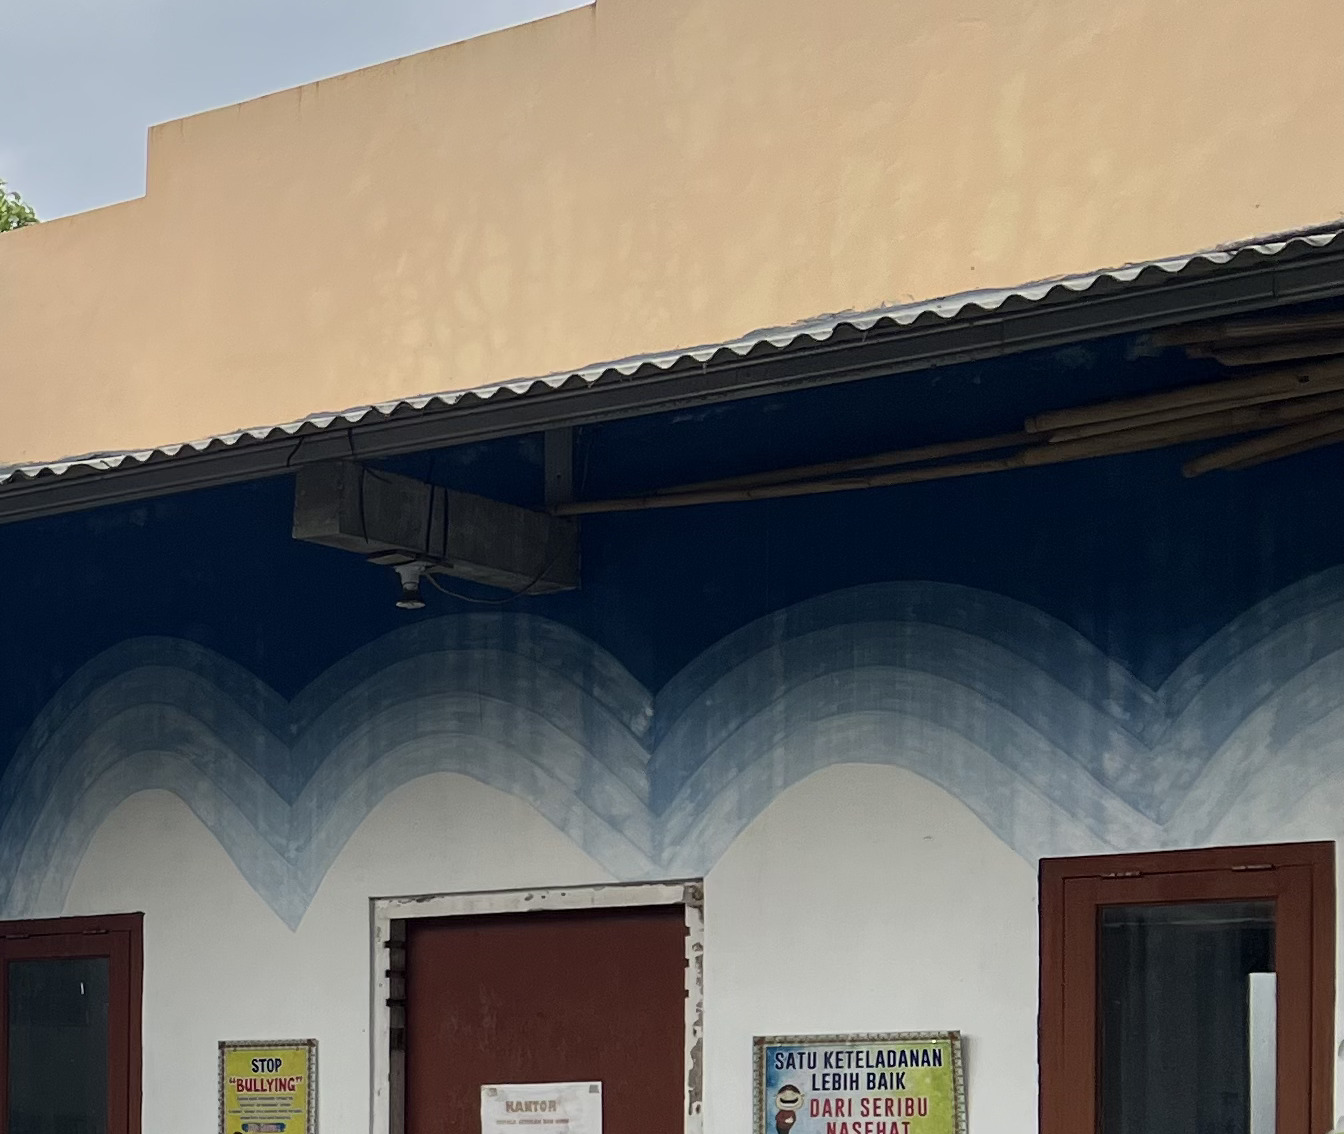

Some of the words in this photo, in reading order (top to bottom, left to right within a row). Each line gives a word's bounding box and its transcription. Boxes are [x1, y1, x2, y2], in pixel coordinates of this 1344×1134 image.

[251, 1058, 283, 1073] STOP
[775, 1051, 817, 1070] SATU
[824, 1048, 943, 1070] KETELADANAN
[228, 1076, 303, 1093] "BULLYING"
[812, 1073, 859, 1091] LEBIH
[866, 1071, 907, 1091] BAIK
[505, 1100, 558, 1113] KANTOR
[809, 1098, 852, 1118] DARI
[860, 1097, 928, 1117] SERIBU
